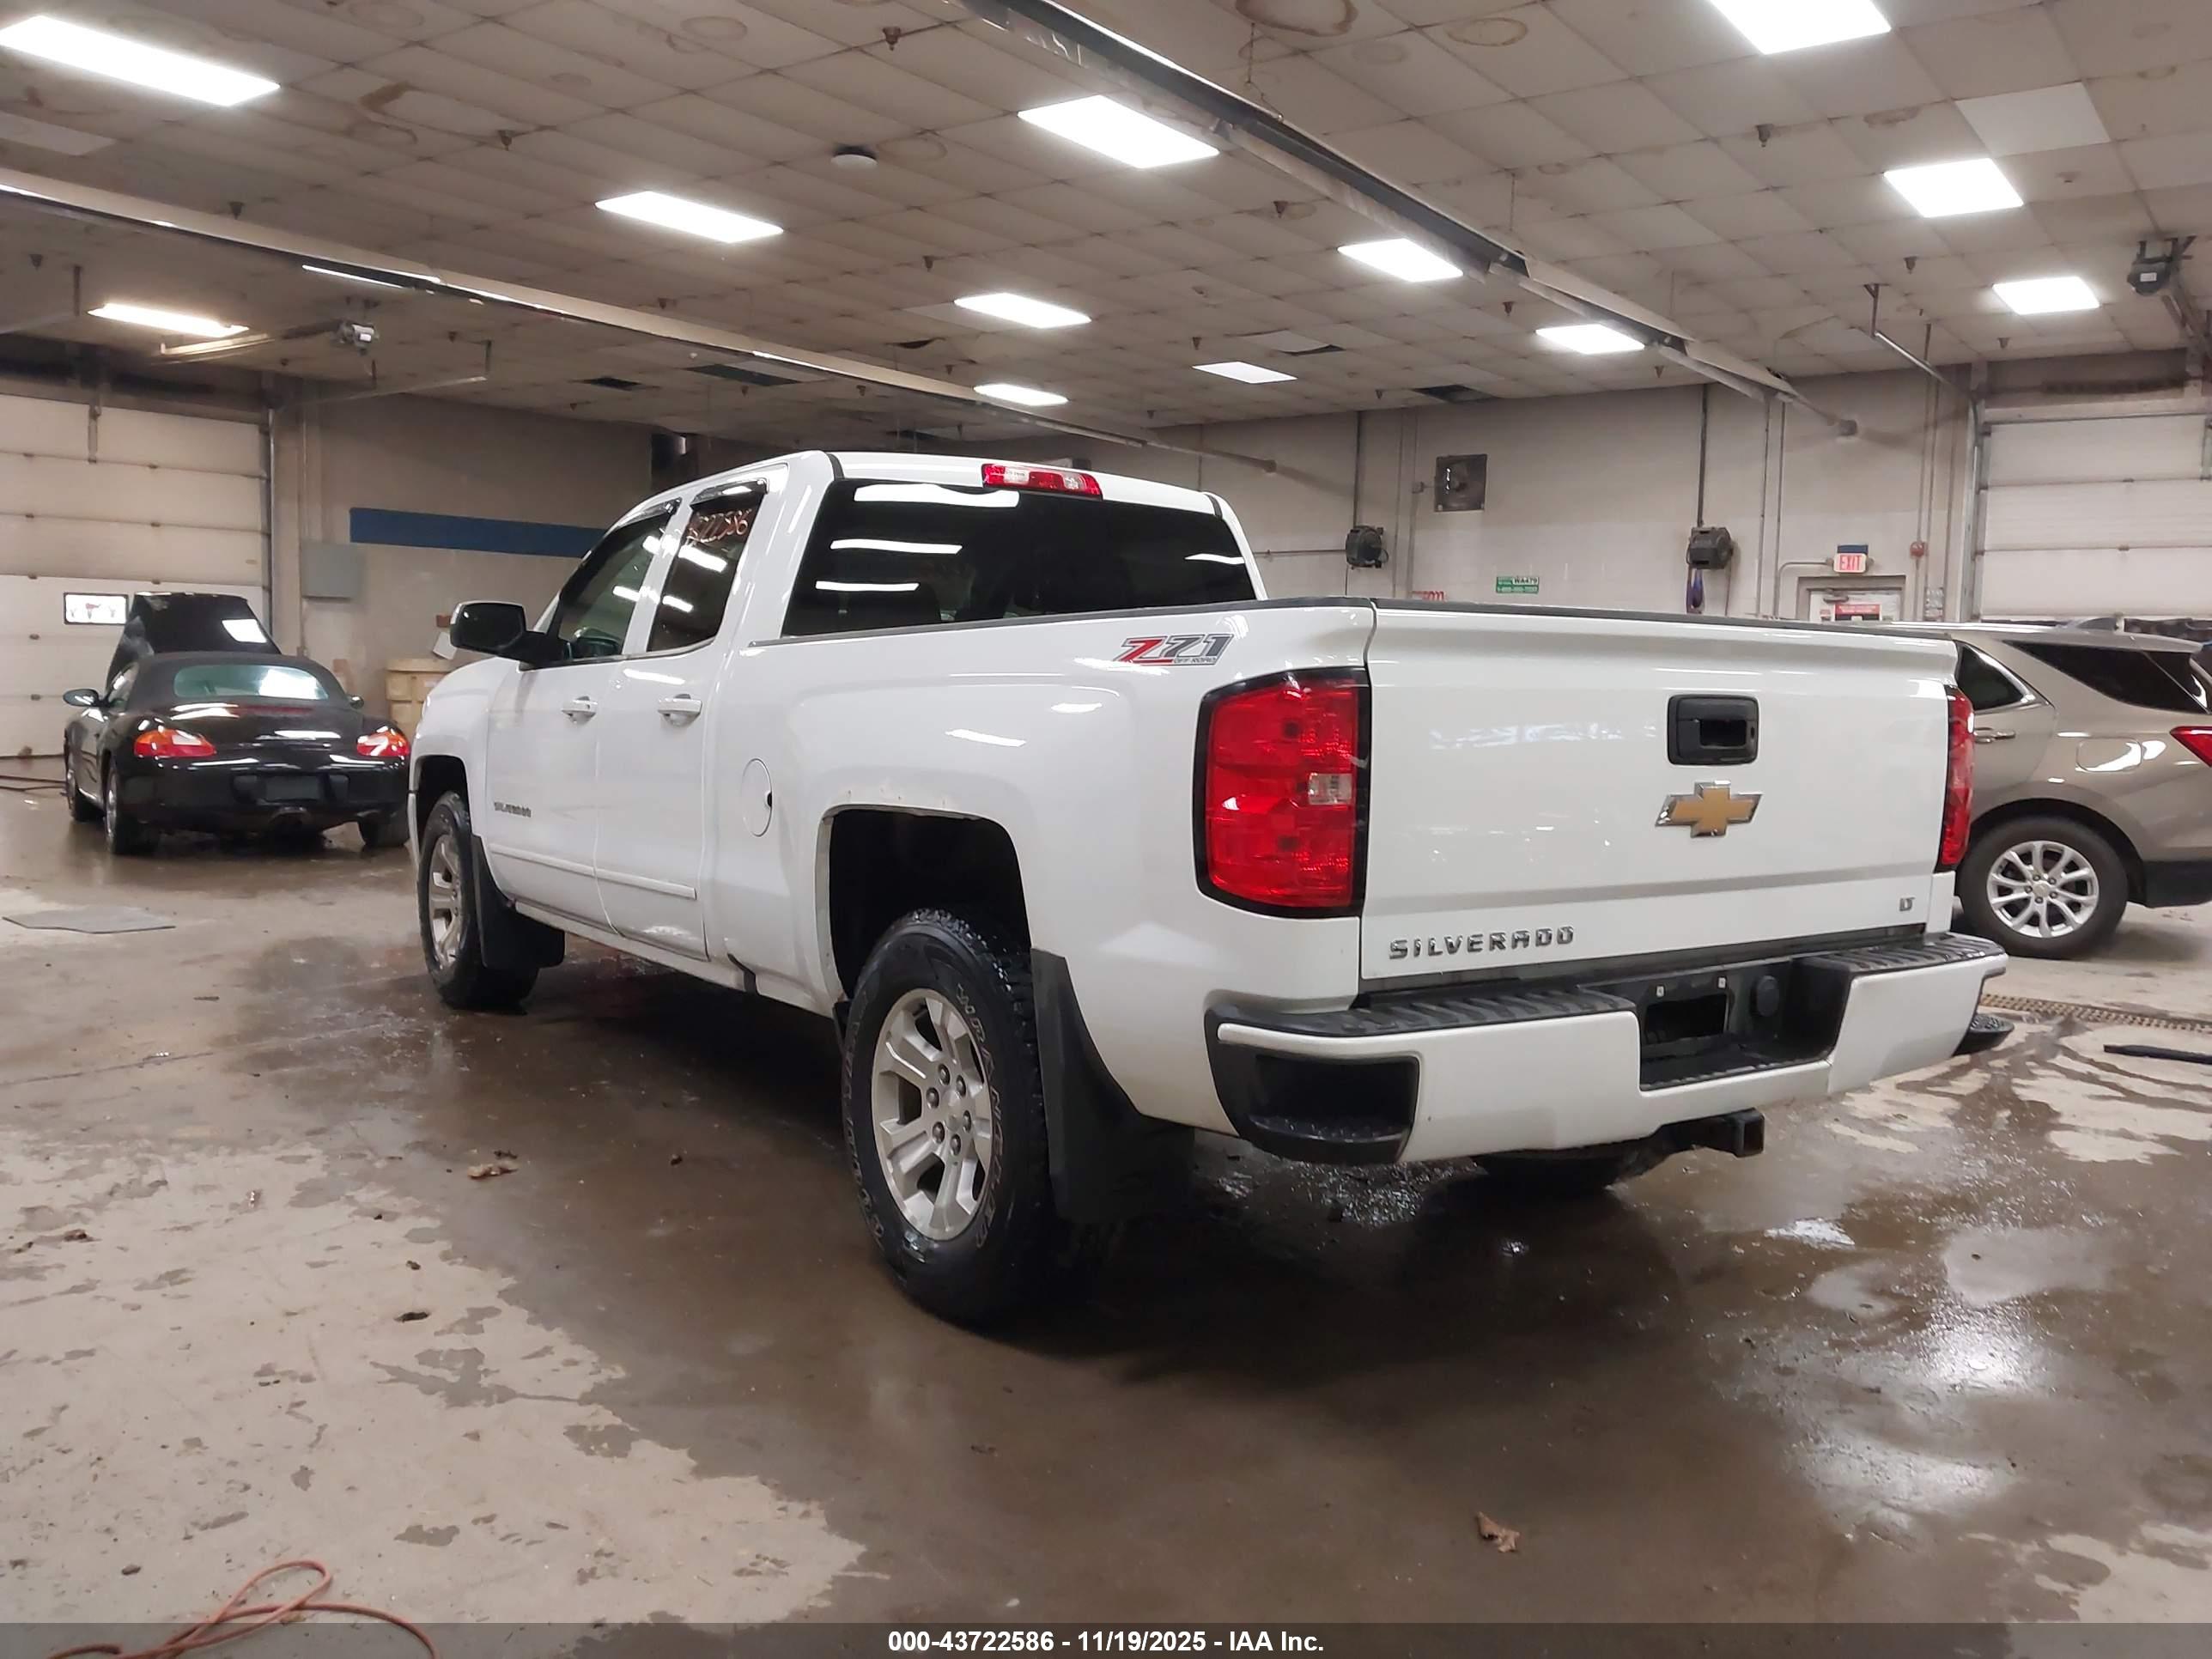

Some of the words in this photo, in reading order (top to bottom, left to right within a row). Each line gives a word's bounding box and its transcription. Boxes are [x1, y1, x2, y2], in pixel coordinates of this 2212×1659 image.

[1840, 555, 1860, 570] EXIT
[1113, 634, 1234, 665] Z71
[1389, 926, 1574, 959] SILVERADO
